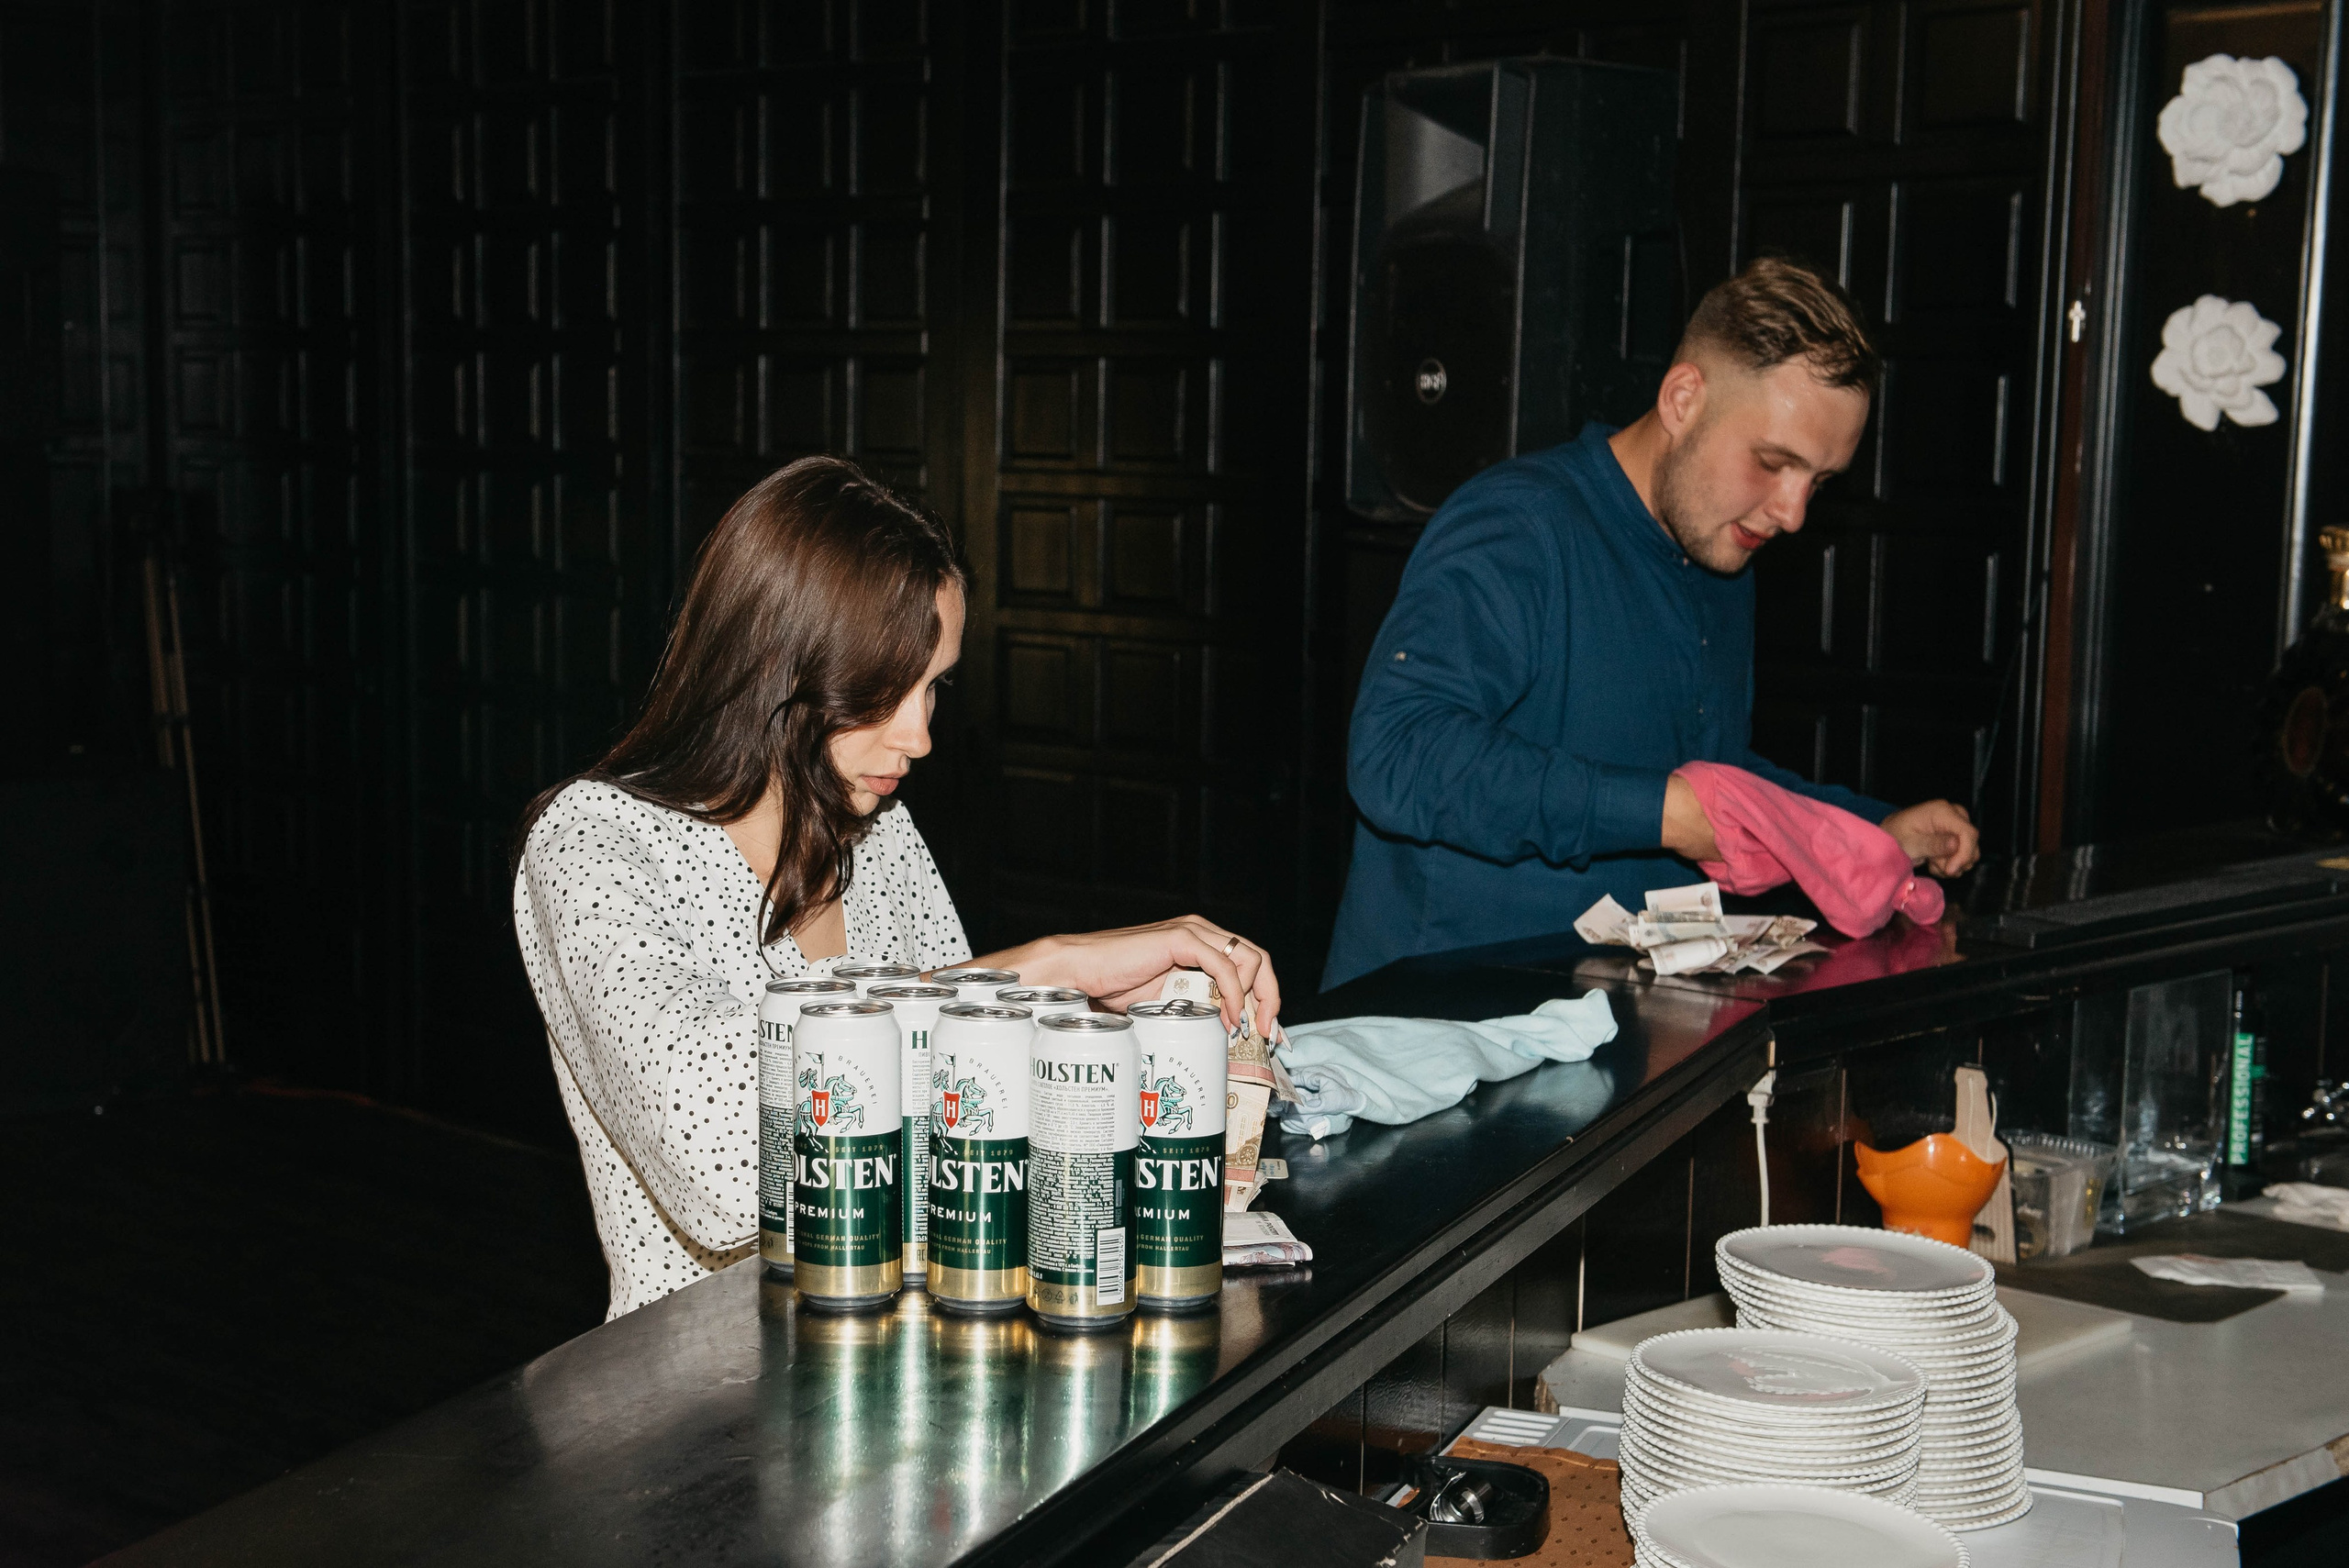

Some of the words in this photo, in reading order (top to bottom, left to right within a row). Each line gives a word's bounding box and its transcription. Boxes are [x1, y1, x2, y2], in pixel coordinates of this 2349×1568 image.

[1030, 1055, 1115, 1084] HOLSTEN
[838, 1055, 877, 1105] BRAUEREI
[969, 1058, 1008, 1108] BRAUEREI
[1168, 1056, 1206, 1106] BRAUEREI
[815, 1098, 826, 1118] H
[946, 1100, 956, 1118] H
[1143, 1099, 1155, 1118] H
[2231, 1036, 2254, 1164] PROFESSIONAL
[863, 1144, 884, 1152] 1879
[929, 1153, 1025, 1194] LSTEN
[795, 1201, 864, 1219] PREMIUM
[816, 1233, 846, 1241] GERMAN
[849, 1233, 880, 1241] QUALITY
[943, 1235, 972, 1244] GERMAN
[1140, 1233, 1171, 1242] GERMAN
[1174, 1235, 1204, 1243] QUALITY
